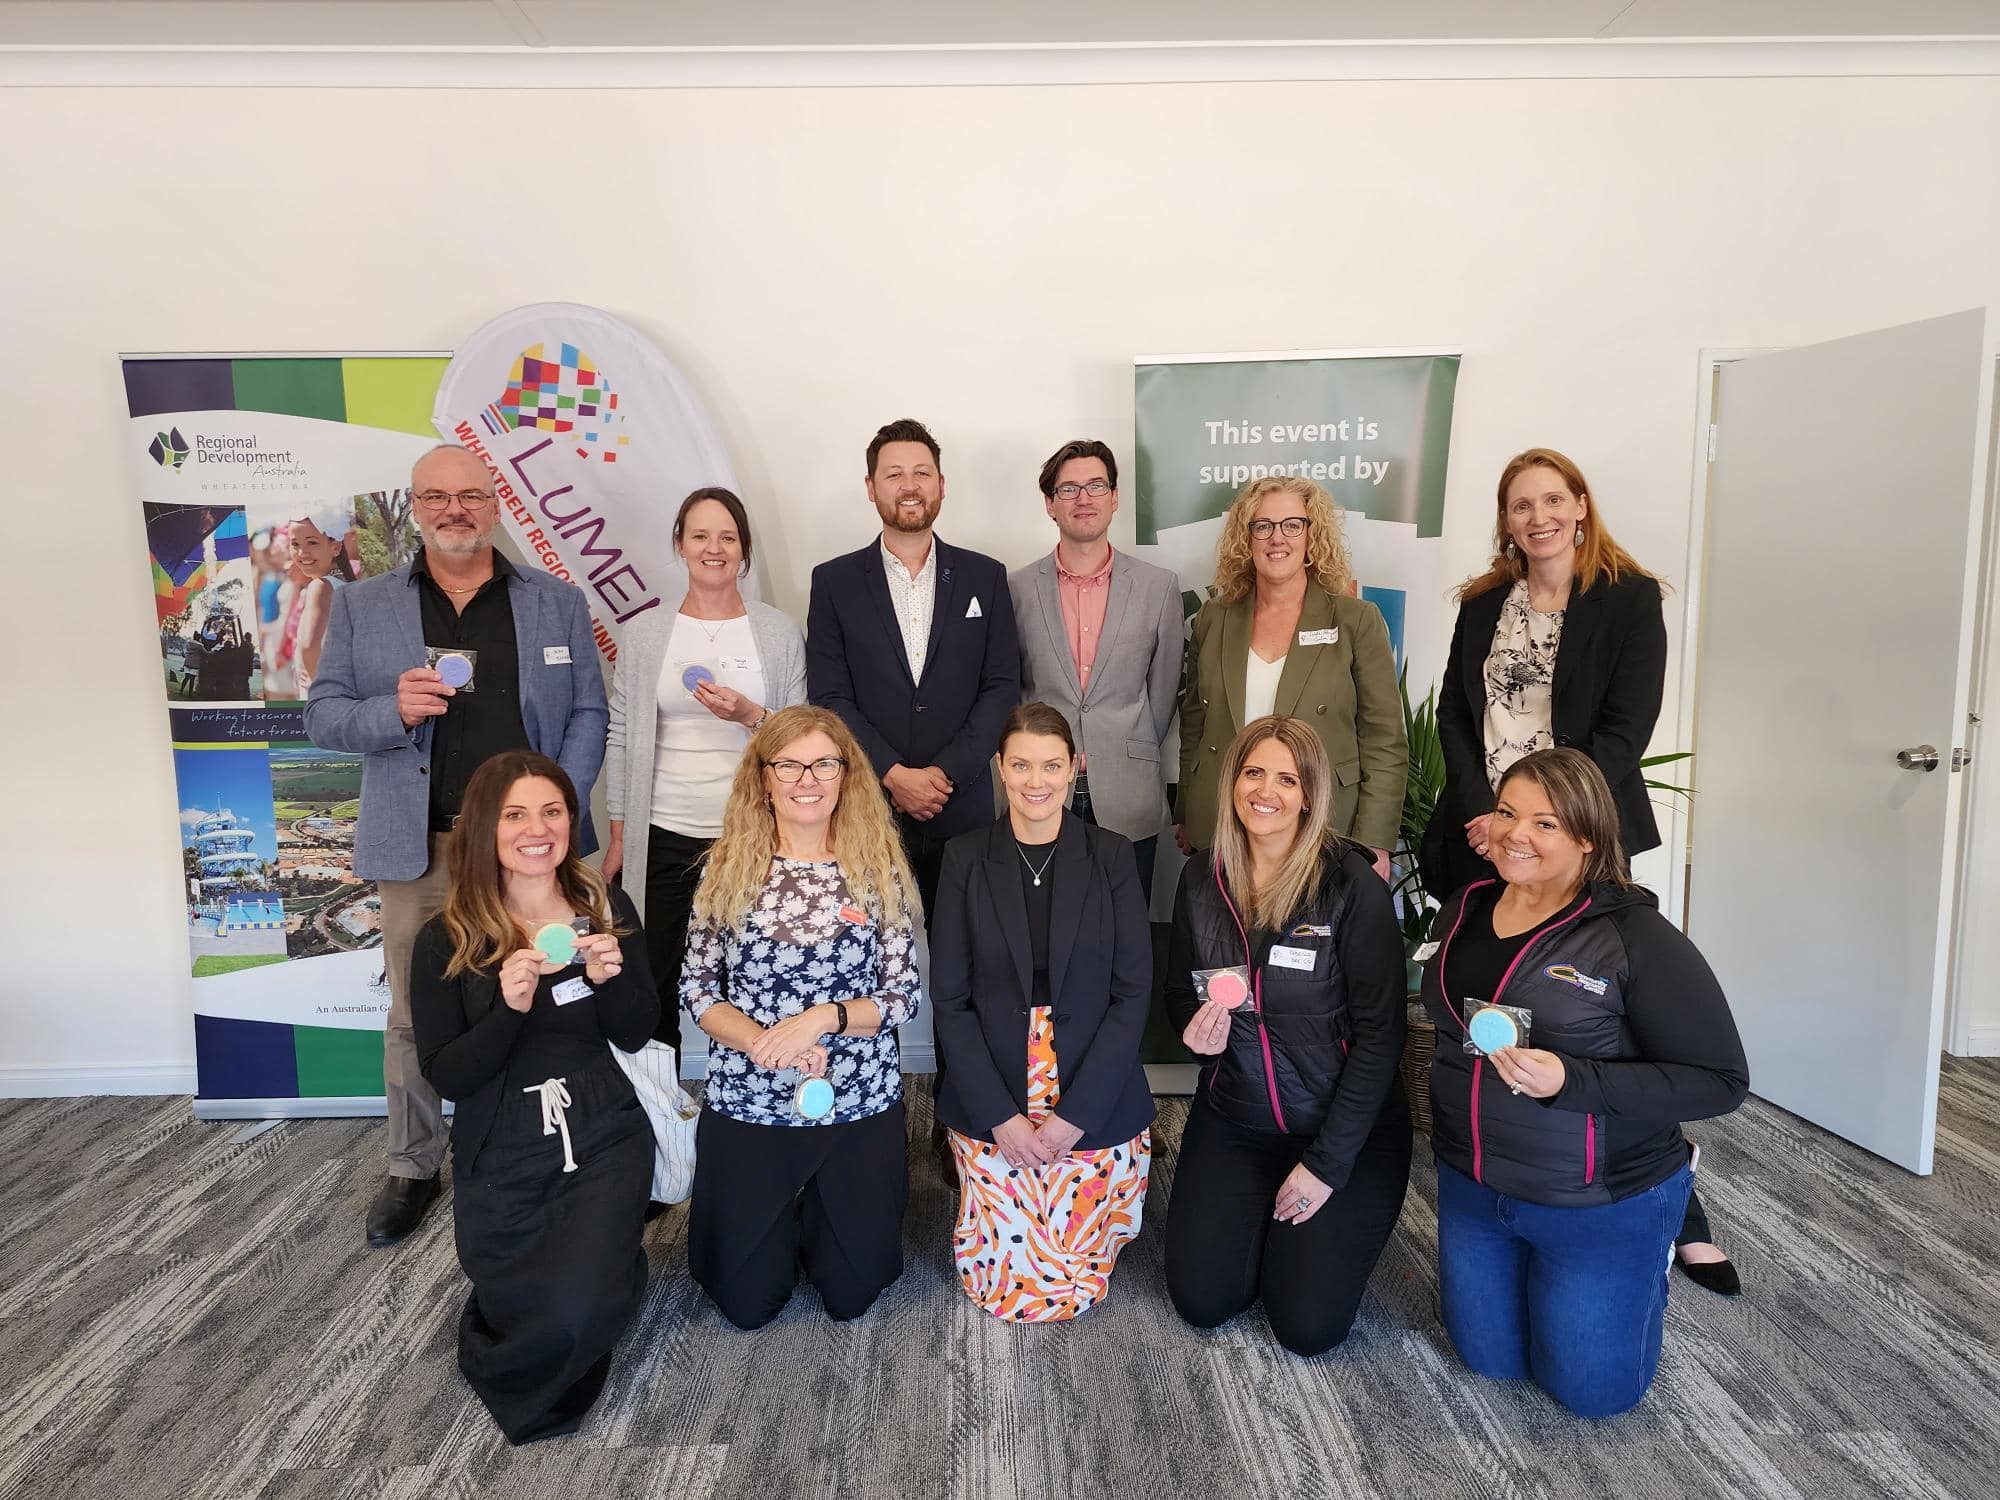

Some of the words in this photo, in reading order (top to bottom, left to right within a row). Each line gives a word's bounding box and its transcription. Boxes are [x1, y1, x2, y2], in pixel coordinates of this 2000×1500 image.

[1204, 419, 1263, 446] This
[1269, 419, 1350, 444] event
[1356, 416, 1379, 441] is
[196, 434, 257, 452] Regional
[197, 449, 292, 467] Development
[252, 460, 307, 478] Australia
[1199, 455, 1346, 489] supported
[1354, 455, 1390, 486] by
[526, 527, 576, 585] REGIO
[191, 710, 238, 727] Working
[241, 710, 253, 721] to
[256, 713, 293, 721] secure
[227, 724, 265, 737] future
[268, 724, 287, 737] for
[332, 1004, 377, 1013] Australian
